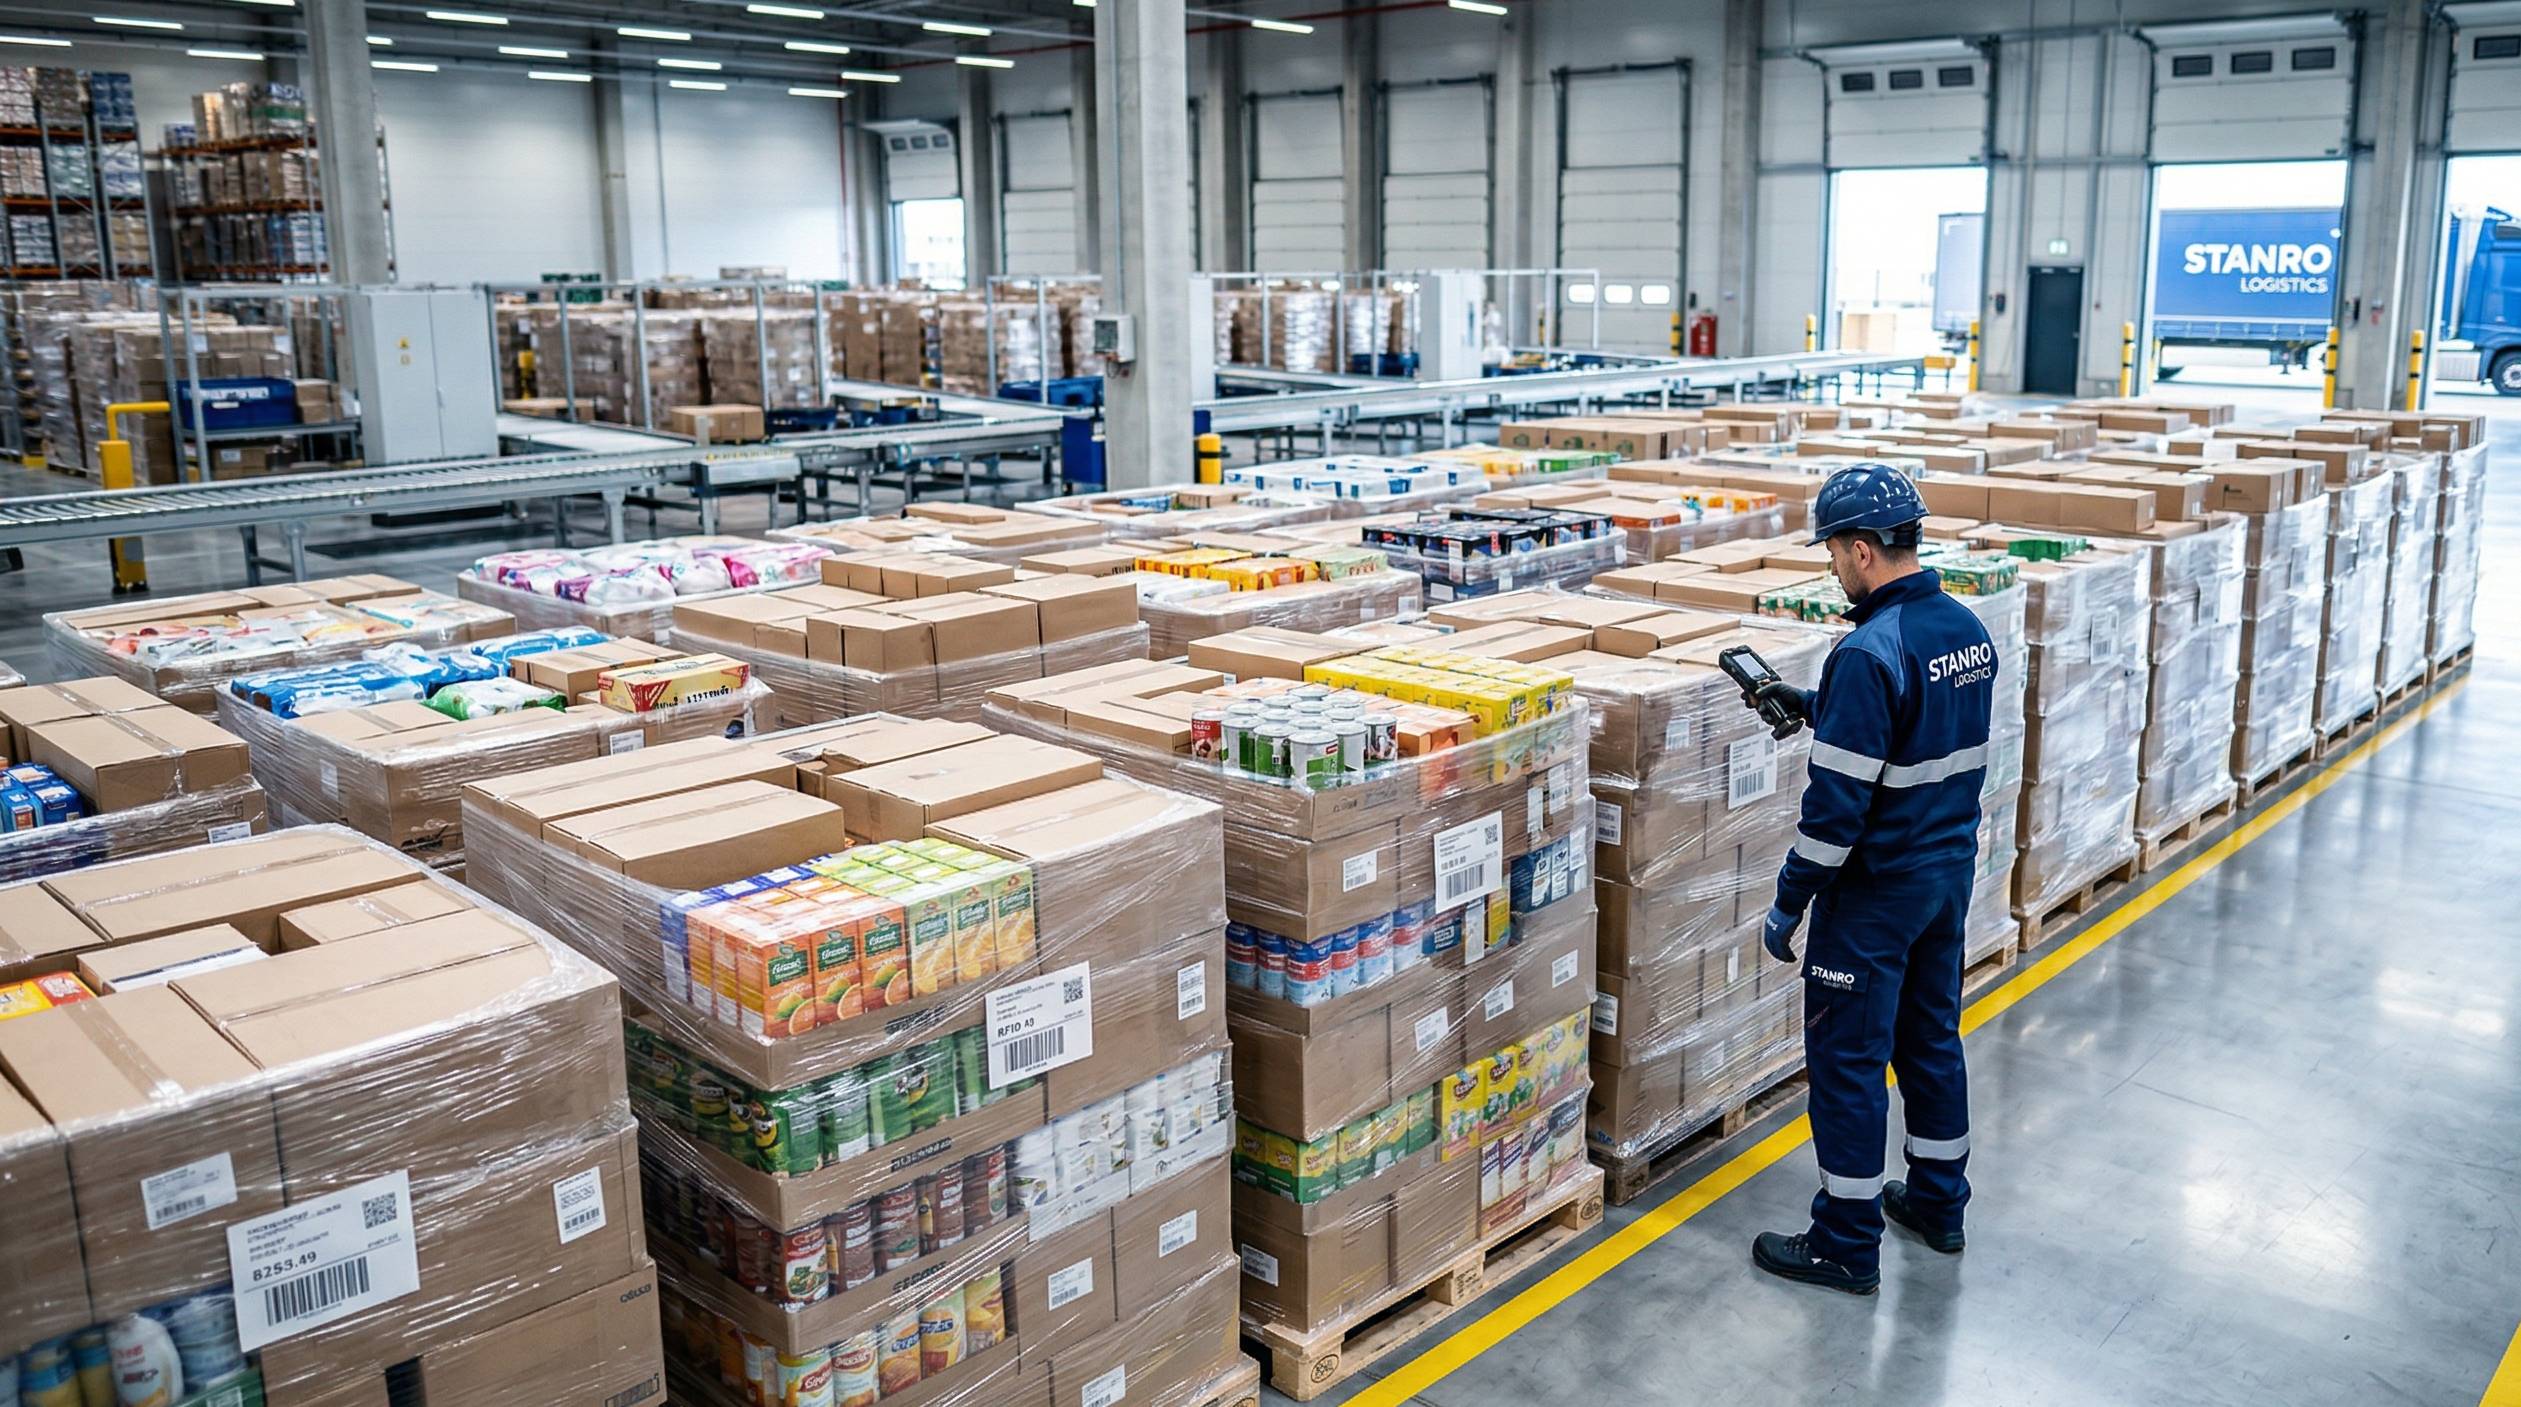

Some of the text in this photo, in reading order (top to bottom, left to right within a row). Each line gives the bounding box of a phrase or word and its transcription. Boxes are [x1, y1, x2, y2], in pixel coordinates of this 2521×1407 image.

[2183, 243, 2333, 275] STANRO
[2240, 277, 2329, 294] LOGISTICS
[1928, 642, 1992, 682] STANRO
[1811, 965, 1855, 985] STANRO
